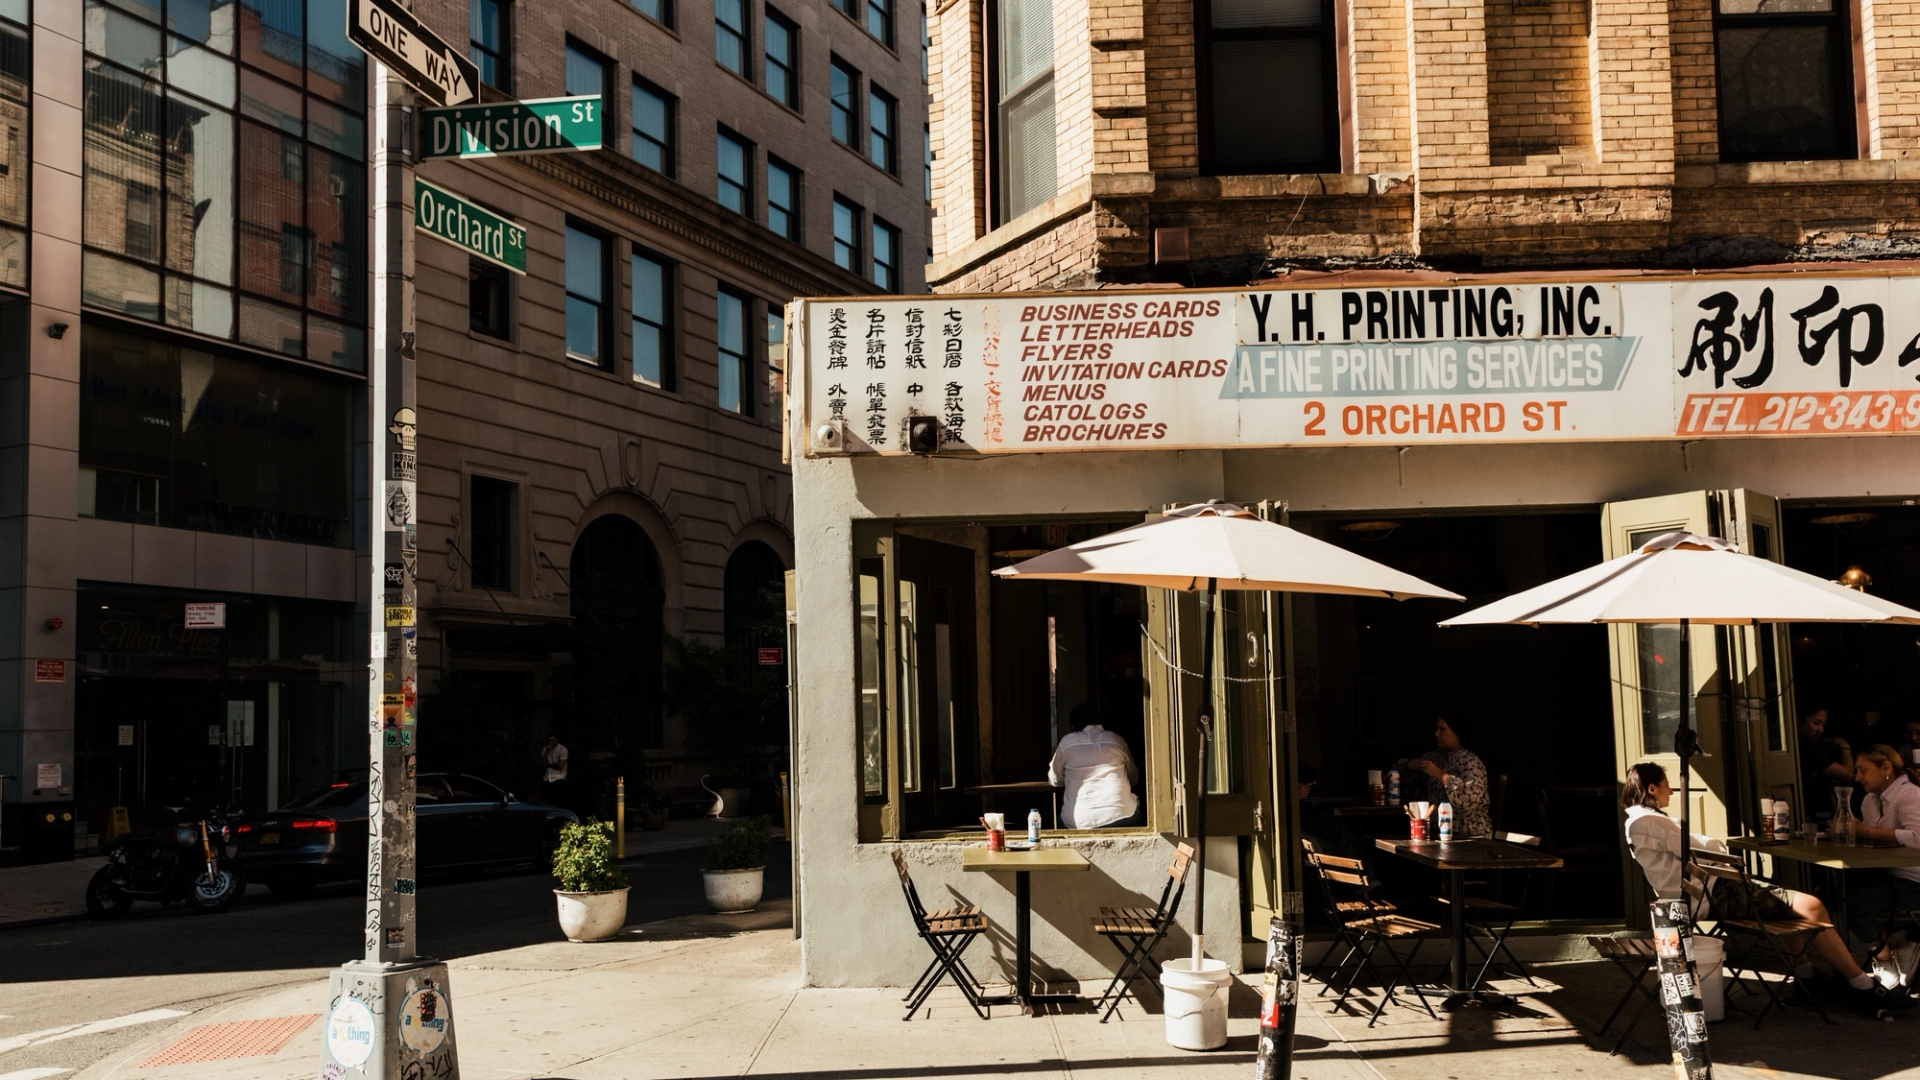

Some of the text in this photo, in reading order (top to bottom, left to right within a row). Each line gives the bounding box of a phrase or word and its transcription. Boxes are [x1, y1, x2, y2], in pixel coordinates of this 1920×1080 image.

[370, 8, 461, 96] ONE WAY
[433, 102, 594, 155] Division St
[420, 189, 522, 260] Orchard St
[1020, 299, 1221, 322] BUSINESS CARDS
[1249, 284, 1612, 343] Y. H. PRINTING, INC.
[904, 307, 927, 369] 信封信紙
[1020, 320, 1195, 342] LETTERHEADS
[1020, 342, 1113, 362] FLYERS
[1238, 342, 1604, 394] A FINE PRINTING SERVICES
[865, 307, 888, 446] 名片請帖 帳單發票
[1021, 359, 1228, 382] INVITATION CARDS
[92, 376, 127, 402] Best
[197, 398, 225, 427] Day
[234, 406, 268, 430] Care
[1022, 383, 1107, 402] MENUS
[943, 381, 966, 444] 各款海報
[1023, 402, 1148, 422] CATOLOGS
[1304, 401, 1577, 437] 2 ORCHARD ST.
[1022, 422, 1168, 442] BROCHURES
[394, 453, 416, 463] RUSSE
[1049, 524, 1066, 547] EXIT
[99, 620, 162, 650] Allen
